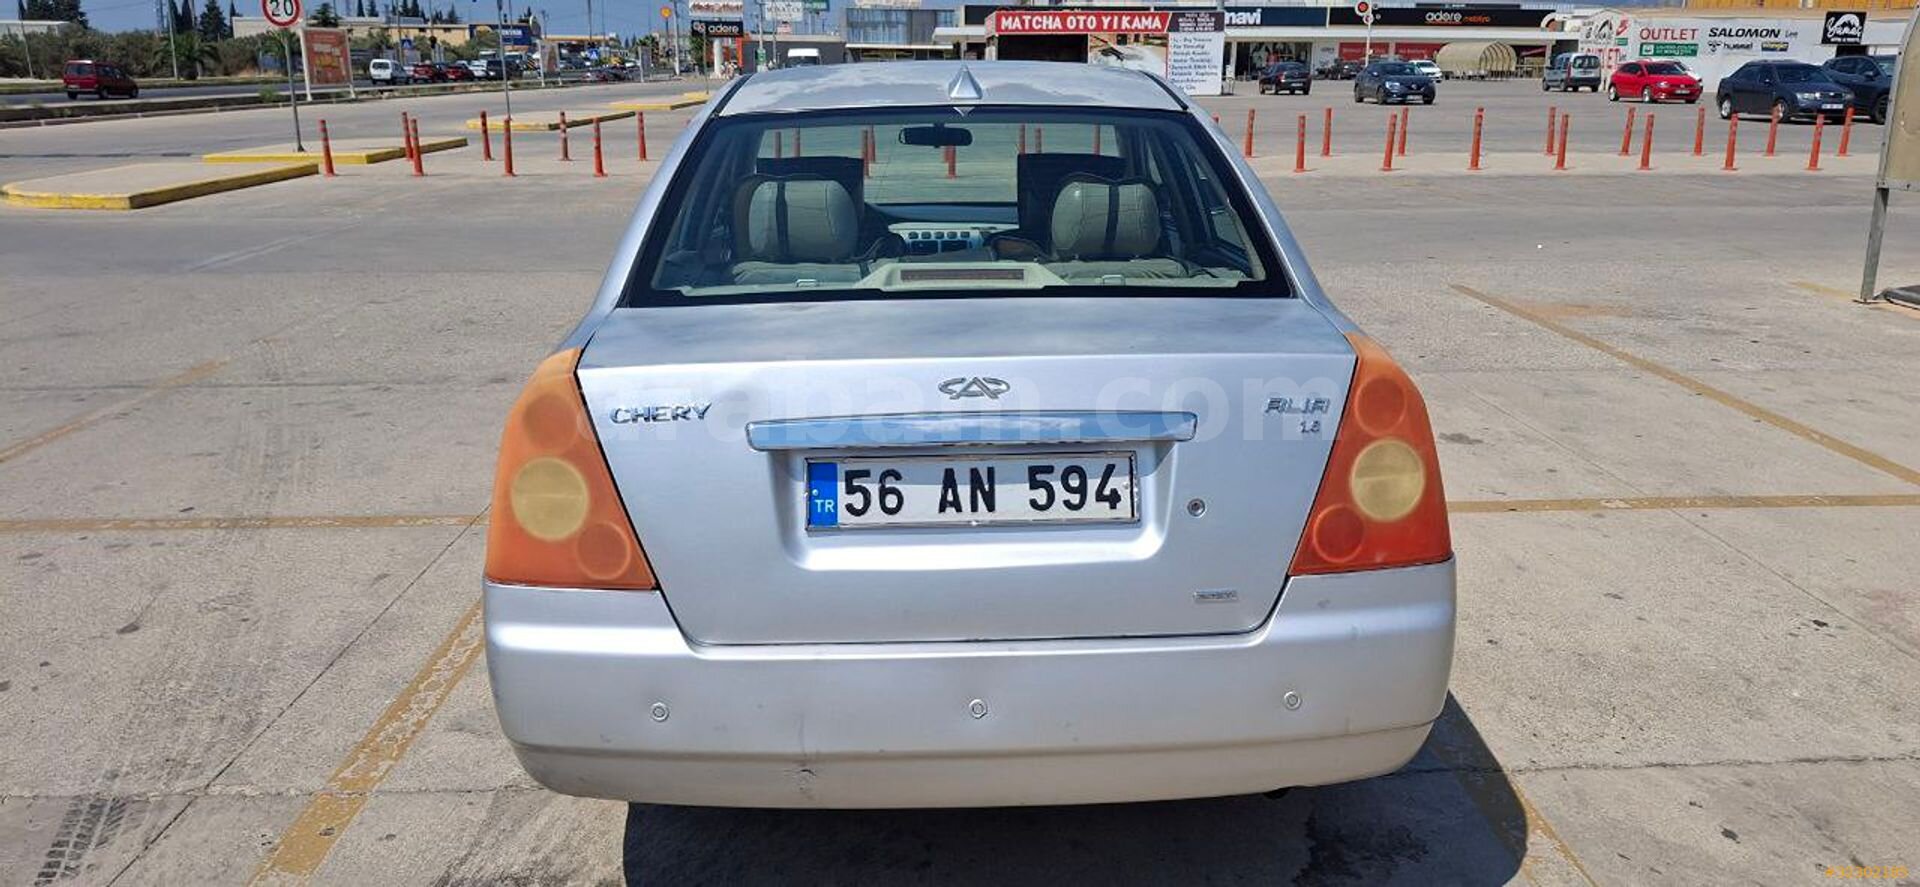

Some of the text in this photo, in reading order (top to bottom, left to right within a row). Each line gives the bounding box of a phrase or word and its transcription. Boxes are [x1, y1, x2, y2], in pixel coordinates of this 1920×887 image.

[269, 0, 294, 17] 20
[708, 24, 739, 33] adore
[1001, 15, 1162, 30] MATCHA OTO YIKAMA
[1640, 28, 1699, 41] OUTLET
[1708, 28, 1781, 38] SALOMON
[610, 402, 712, 424] CHERY
[844, 464, 1122, 517] 56 AN 594
[815, 499, 836, 513] TR
